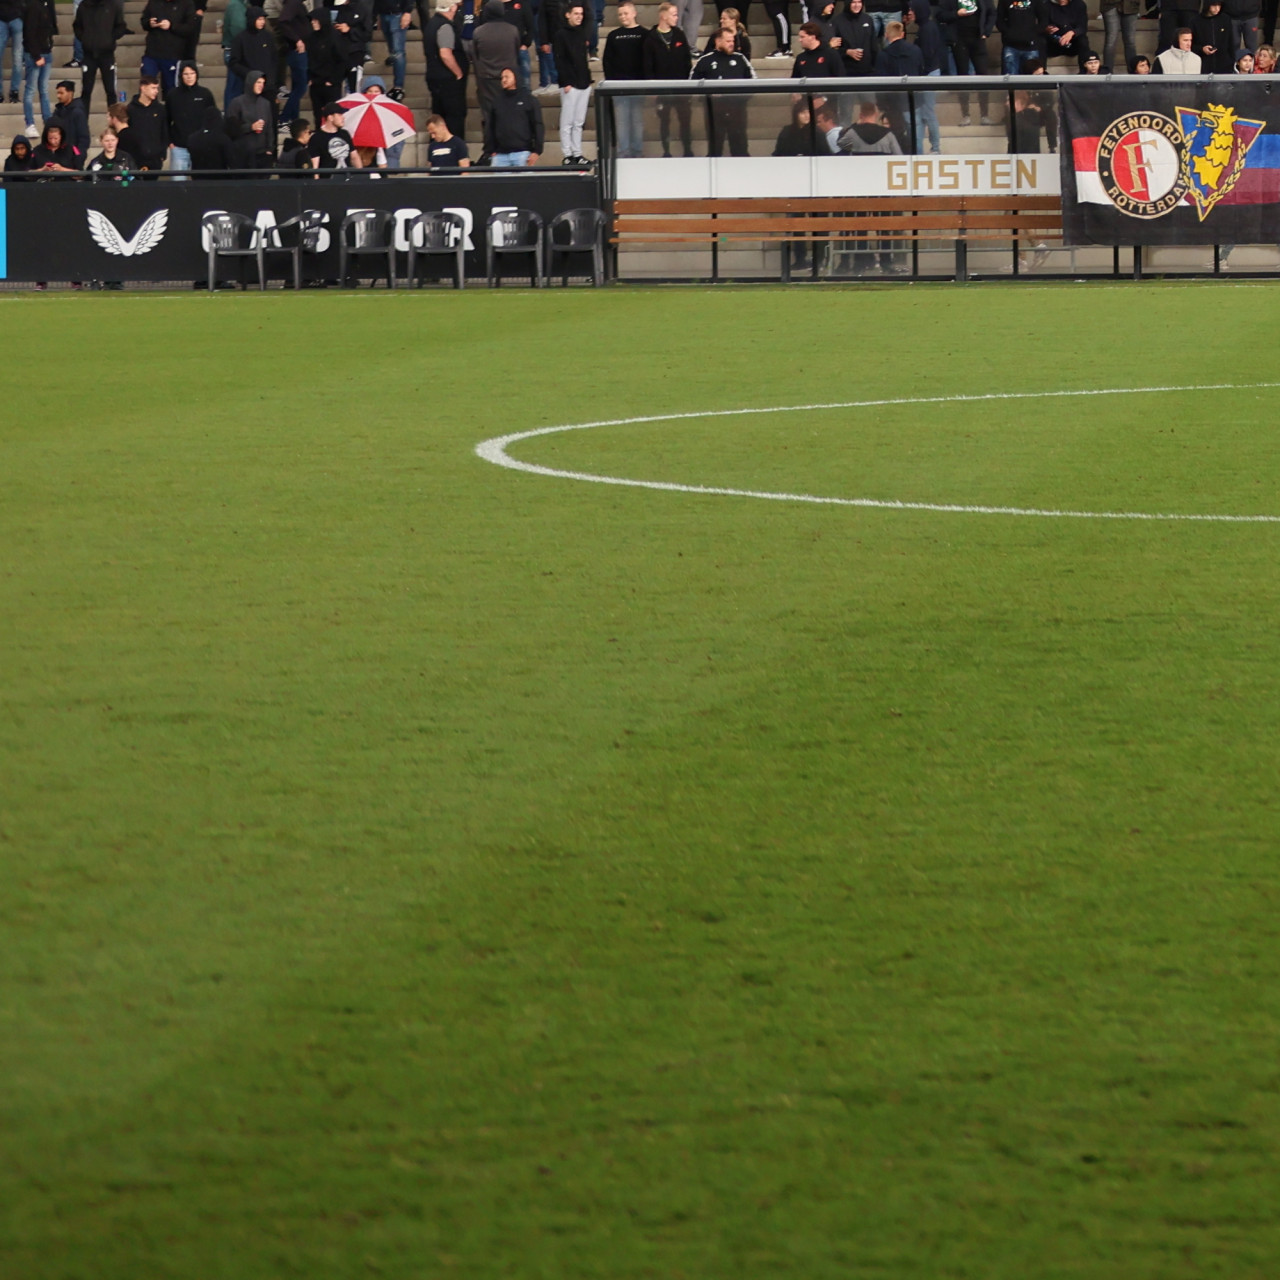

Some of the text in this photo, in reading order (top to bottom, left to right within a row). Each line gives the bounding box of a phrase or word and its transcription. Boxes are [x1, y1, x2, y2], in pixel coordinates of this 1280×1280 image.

[1101, 116, 1182, 158] FEYENOORD
[887, 159, 1037, 190] GASTEN
[1123, 140, 1158, 193] F
